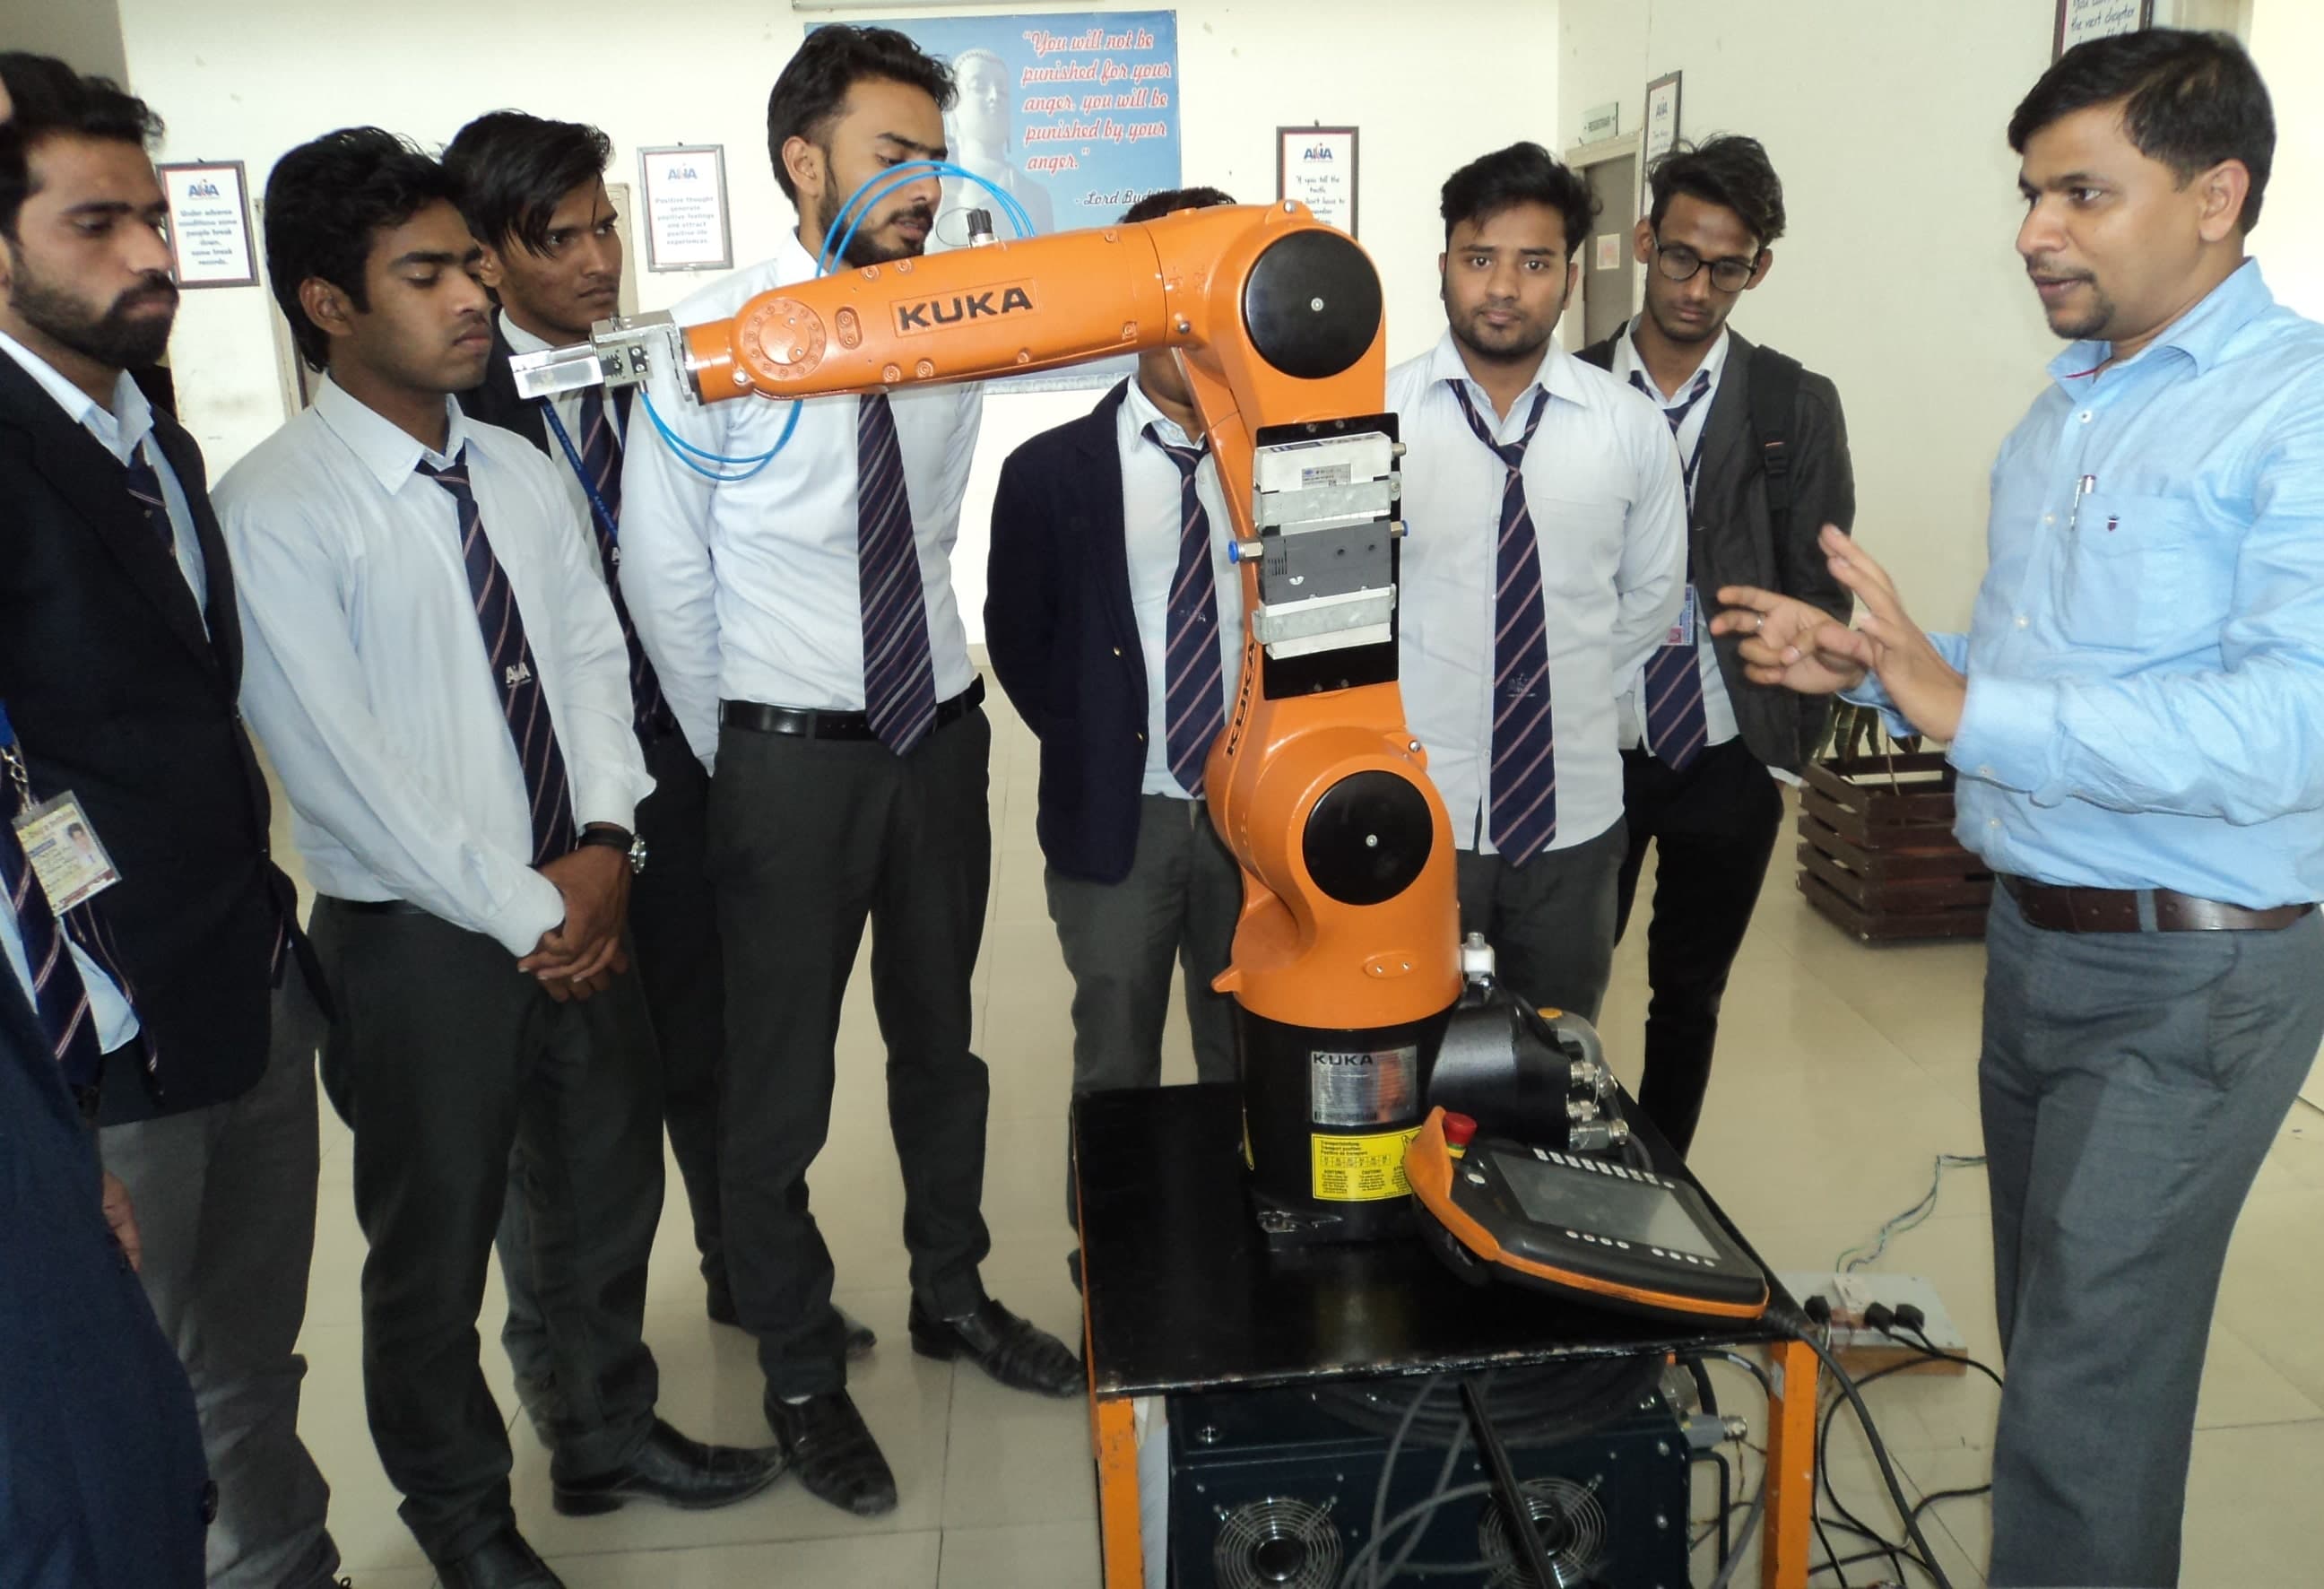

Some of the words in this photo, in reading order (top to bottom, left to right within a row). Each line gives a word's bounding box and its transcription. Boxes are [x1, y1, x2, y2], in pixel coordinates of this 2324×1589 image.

[2086, 10, 2102, 28] next
[2105, 3, 2136, 26] chapter
[1070, 29, 1103, 50] will
[1105, 30, 1134, 50] not
[1135, 28, 1154, 49] be
[1021, 59, 1099, 87] punished
[1100, 58, 1128, 84] for
[1131, 62, 1172, 83] your
[1079, 93, 1113, 114] you
[1116, 88, 1149, 109] will
[1149, 87, 1168, 108] be
[1024, 119, 1101, 146] punished
[1103, 118, 1123, 143] by
[1127, 122, 1167, 143] your
[1083, 188, 1120, 206] Lord
[898, 286, 1034, 331] KUKA
[1314, 1054, 1374, 1066] KUKA
